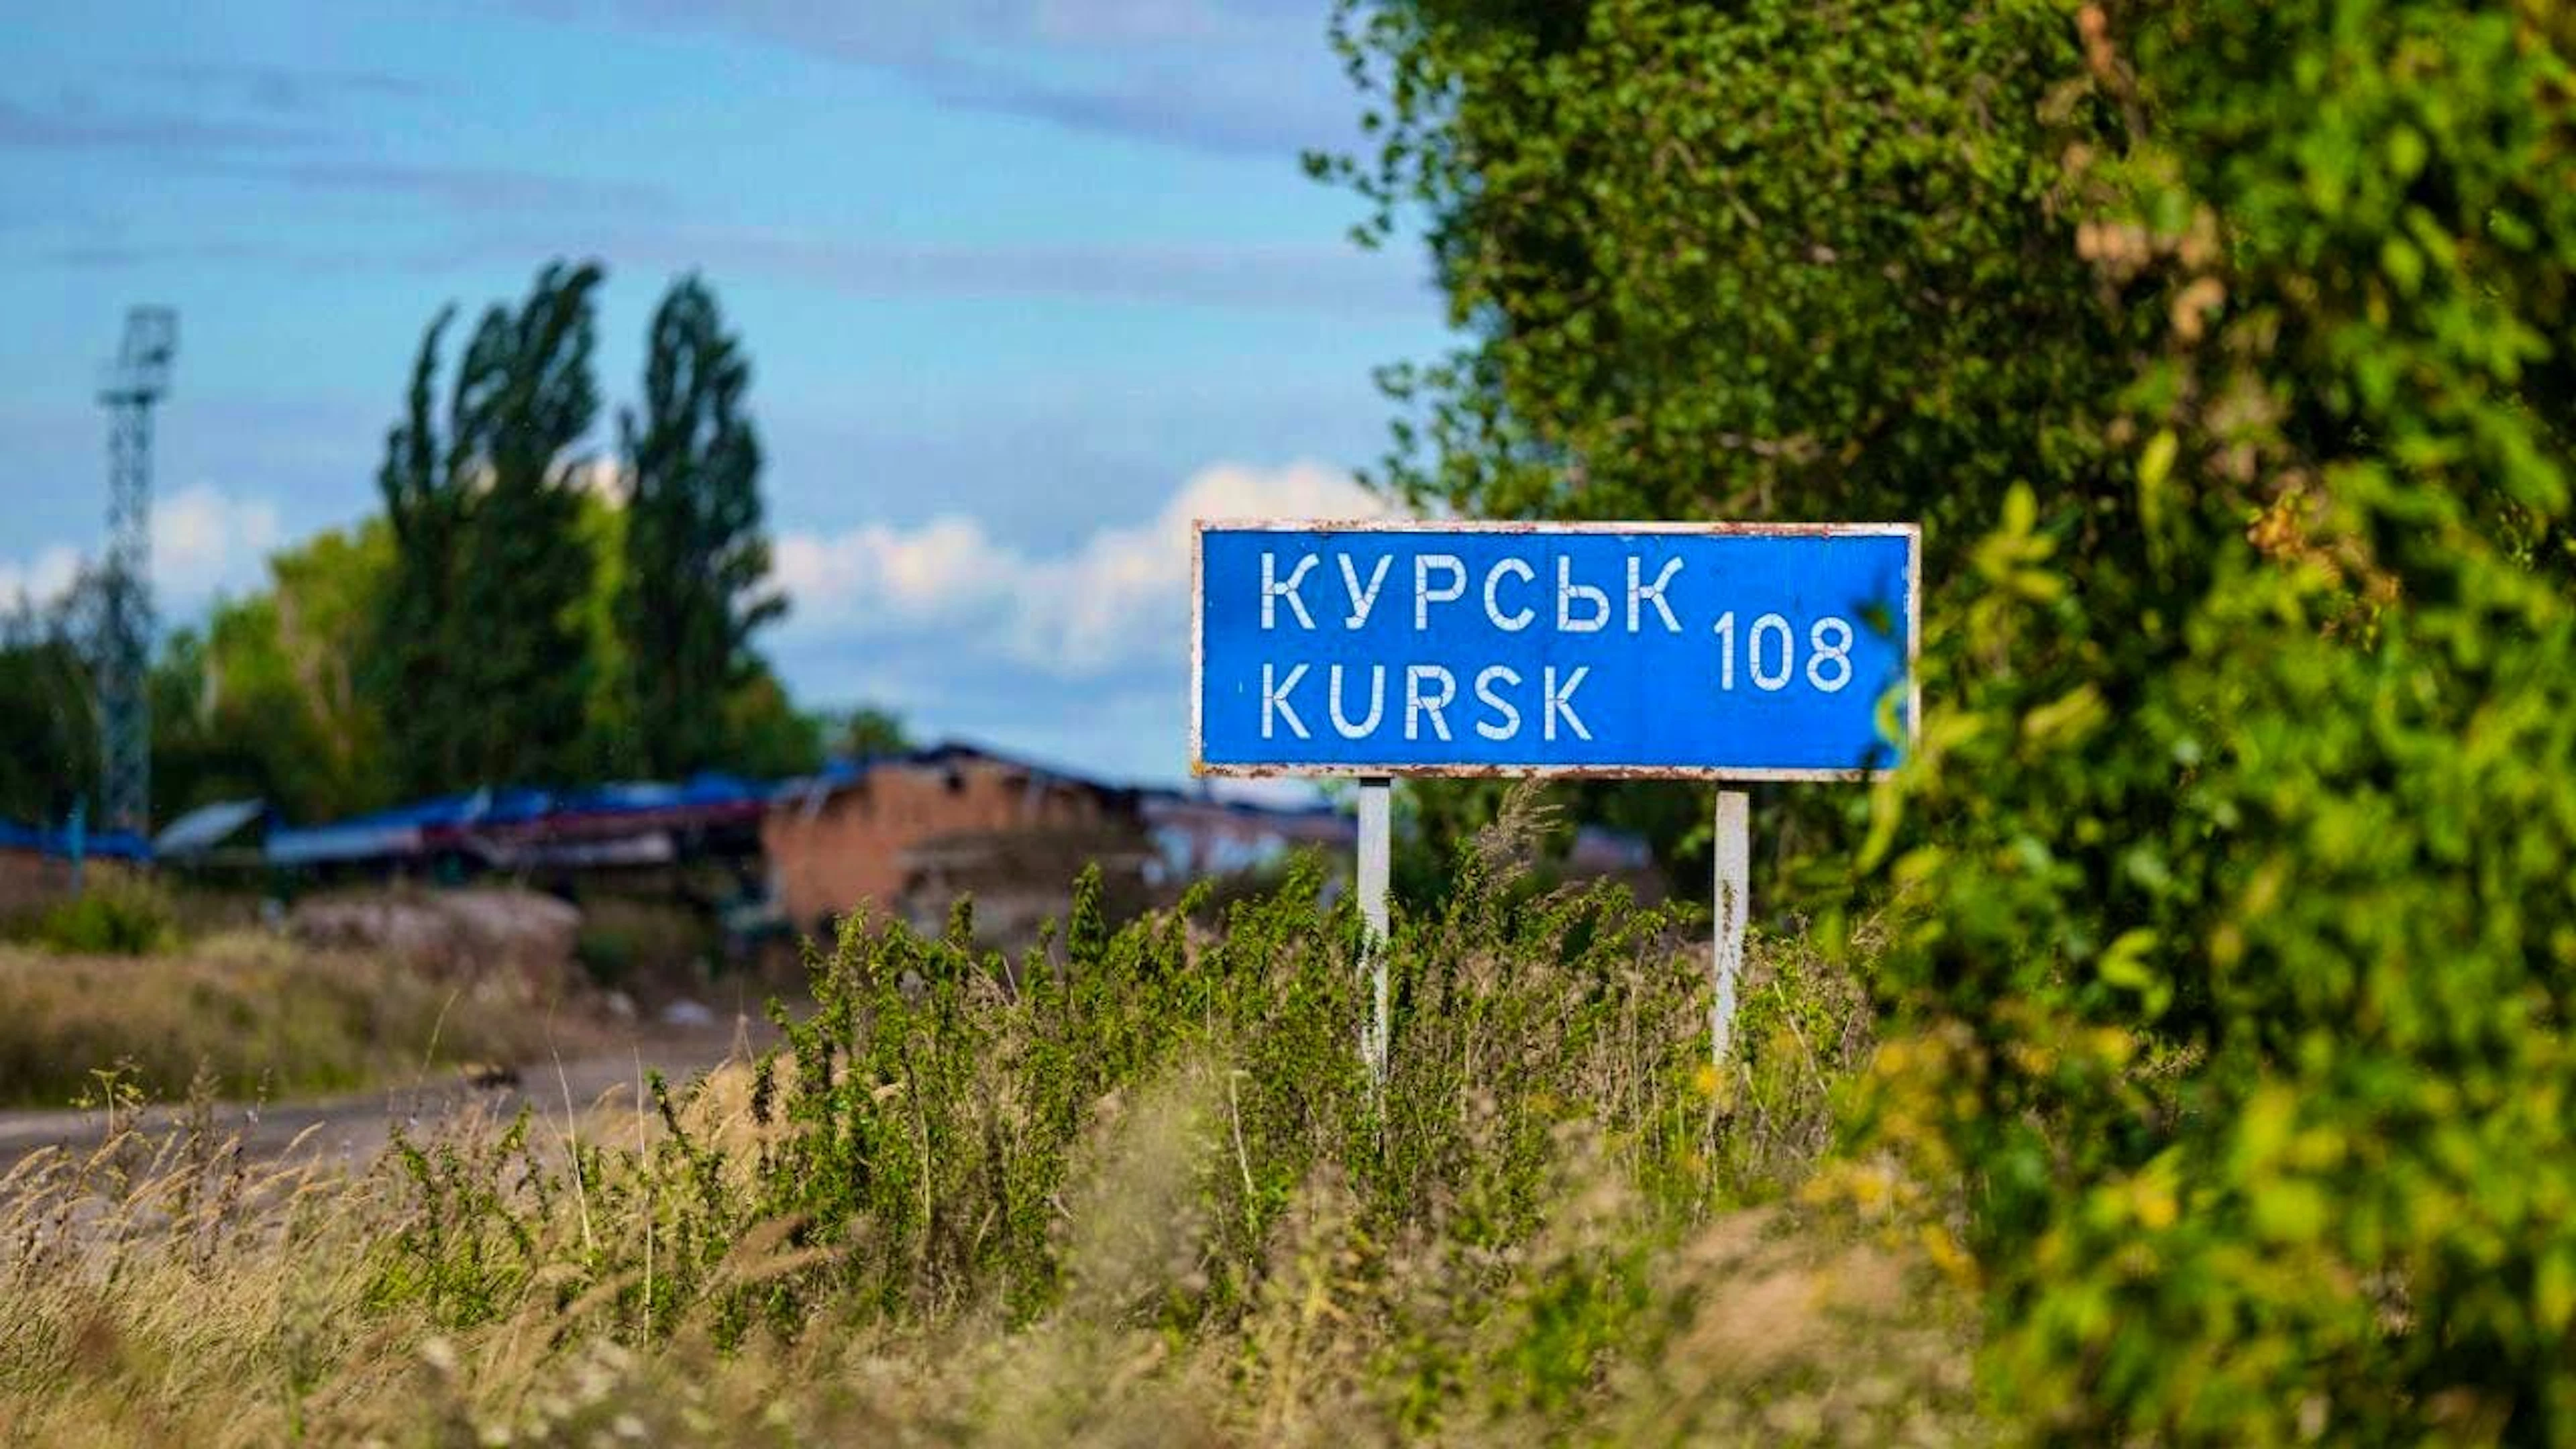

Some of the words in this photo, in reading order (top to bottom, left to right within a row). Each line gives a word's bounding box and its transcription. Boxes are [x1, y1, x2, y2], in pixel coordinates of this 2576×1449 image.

[1261, 553, 1684, 632] КУРСЬК
[1713, 610, 1856, 693] 108
[1261, 663, 1592, 742] KURSK
